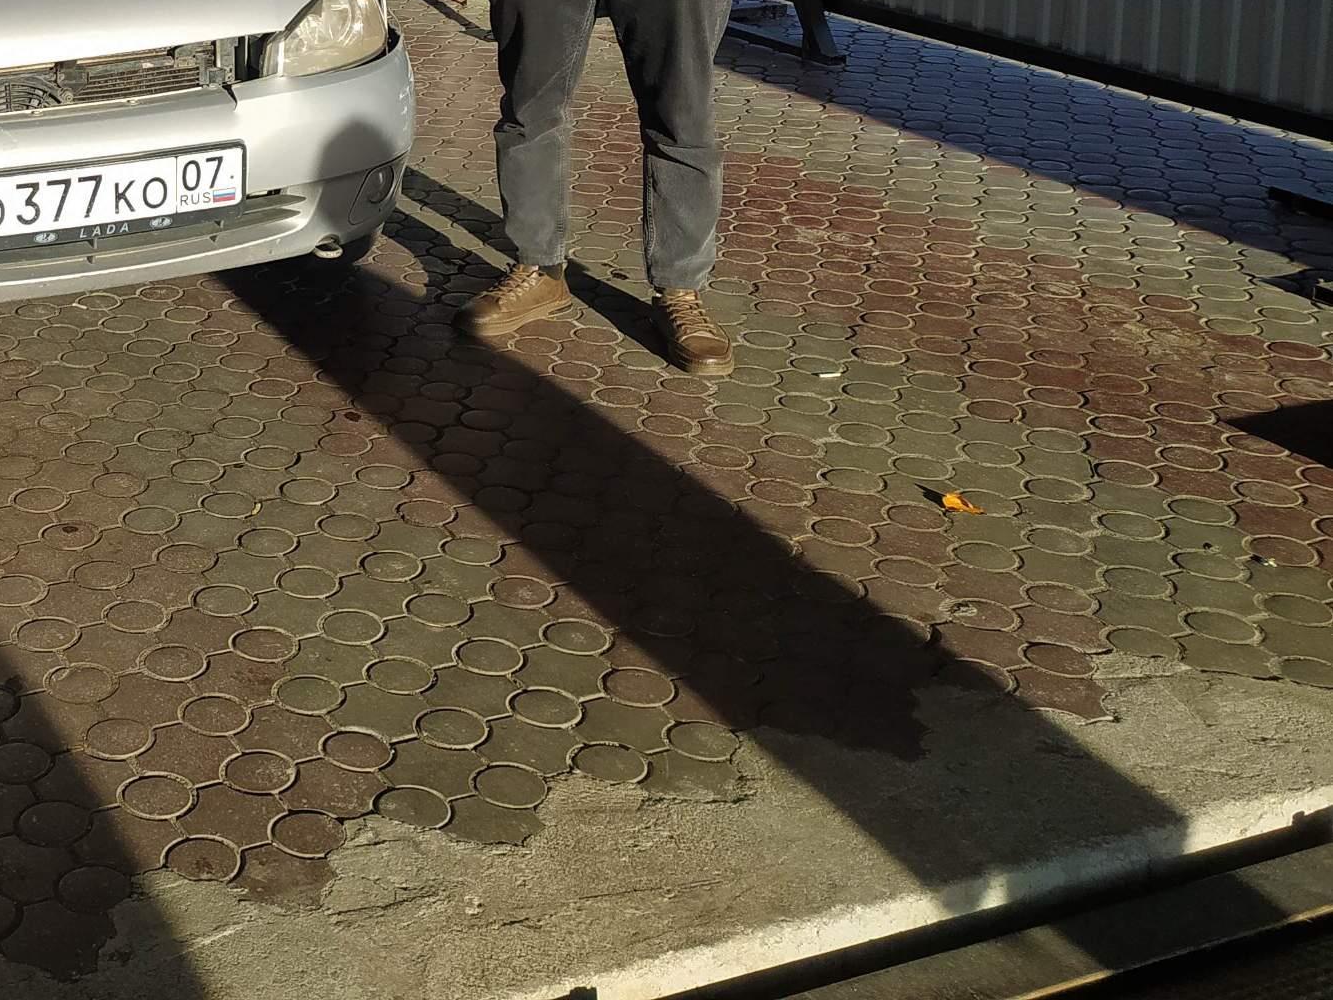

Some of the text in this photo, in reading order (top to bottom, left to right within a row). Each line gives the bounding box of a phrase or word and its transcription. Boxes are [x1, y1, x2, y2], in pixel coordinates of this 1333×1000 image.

[181, 156, 224, 192] 07
[179, 191, 212, 207] RUS
[79, 222, 129, 239] LADA
